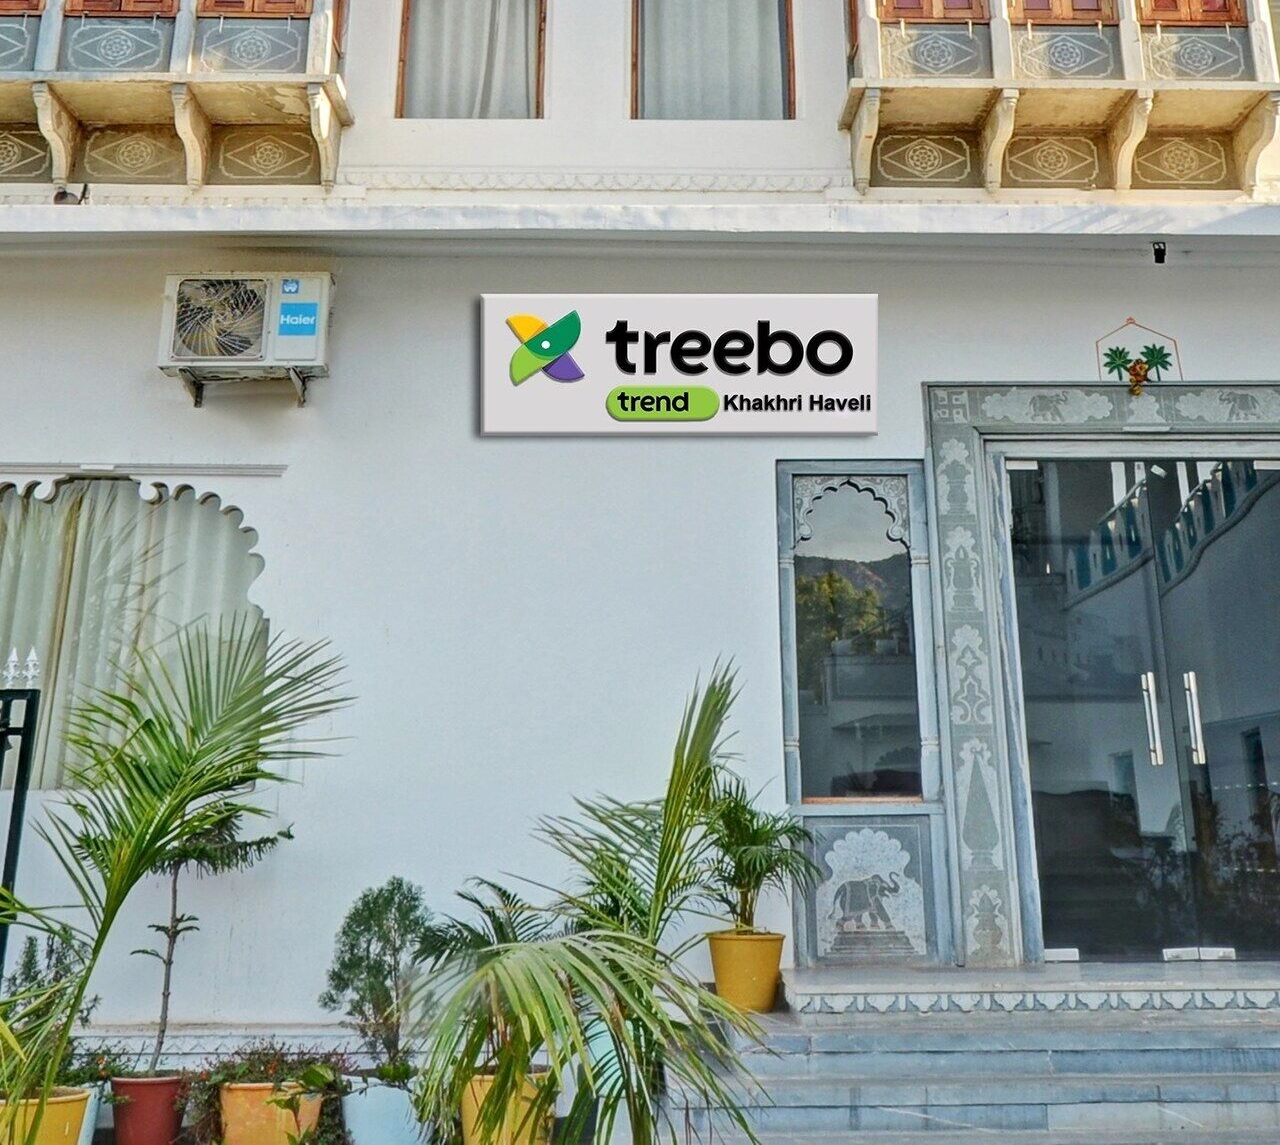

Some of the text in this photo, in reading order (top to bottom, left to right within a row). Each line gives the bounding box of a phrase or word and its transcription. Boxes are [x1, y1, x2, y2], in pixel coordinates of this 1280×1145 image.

[280, 314, 316, 325] Haier
[605, 320, 854, 376] treebo
[617, 391, 872, 412] trend Khakhri Haveli
